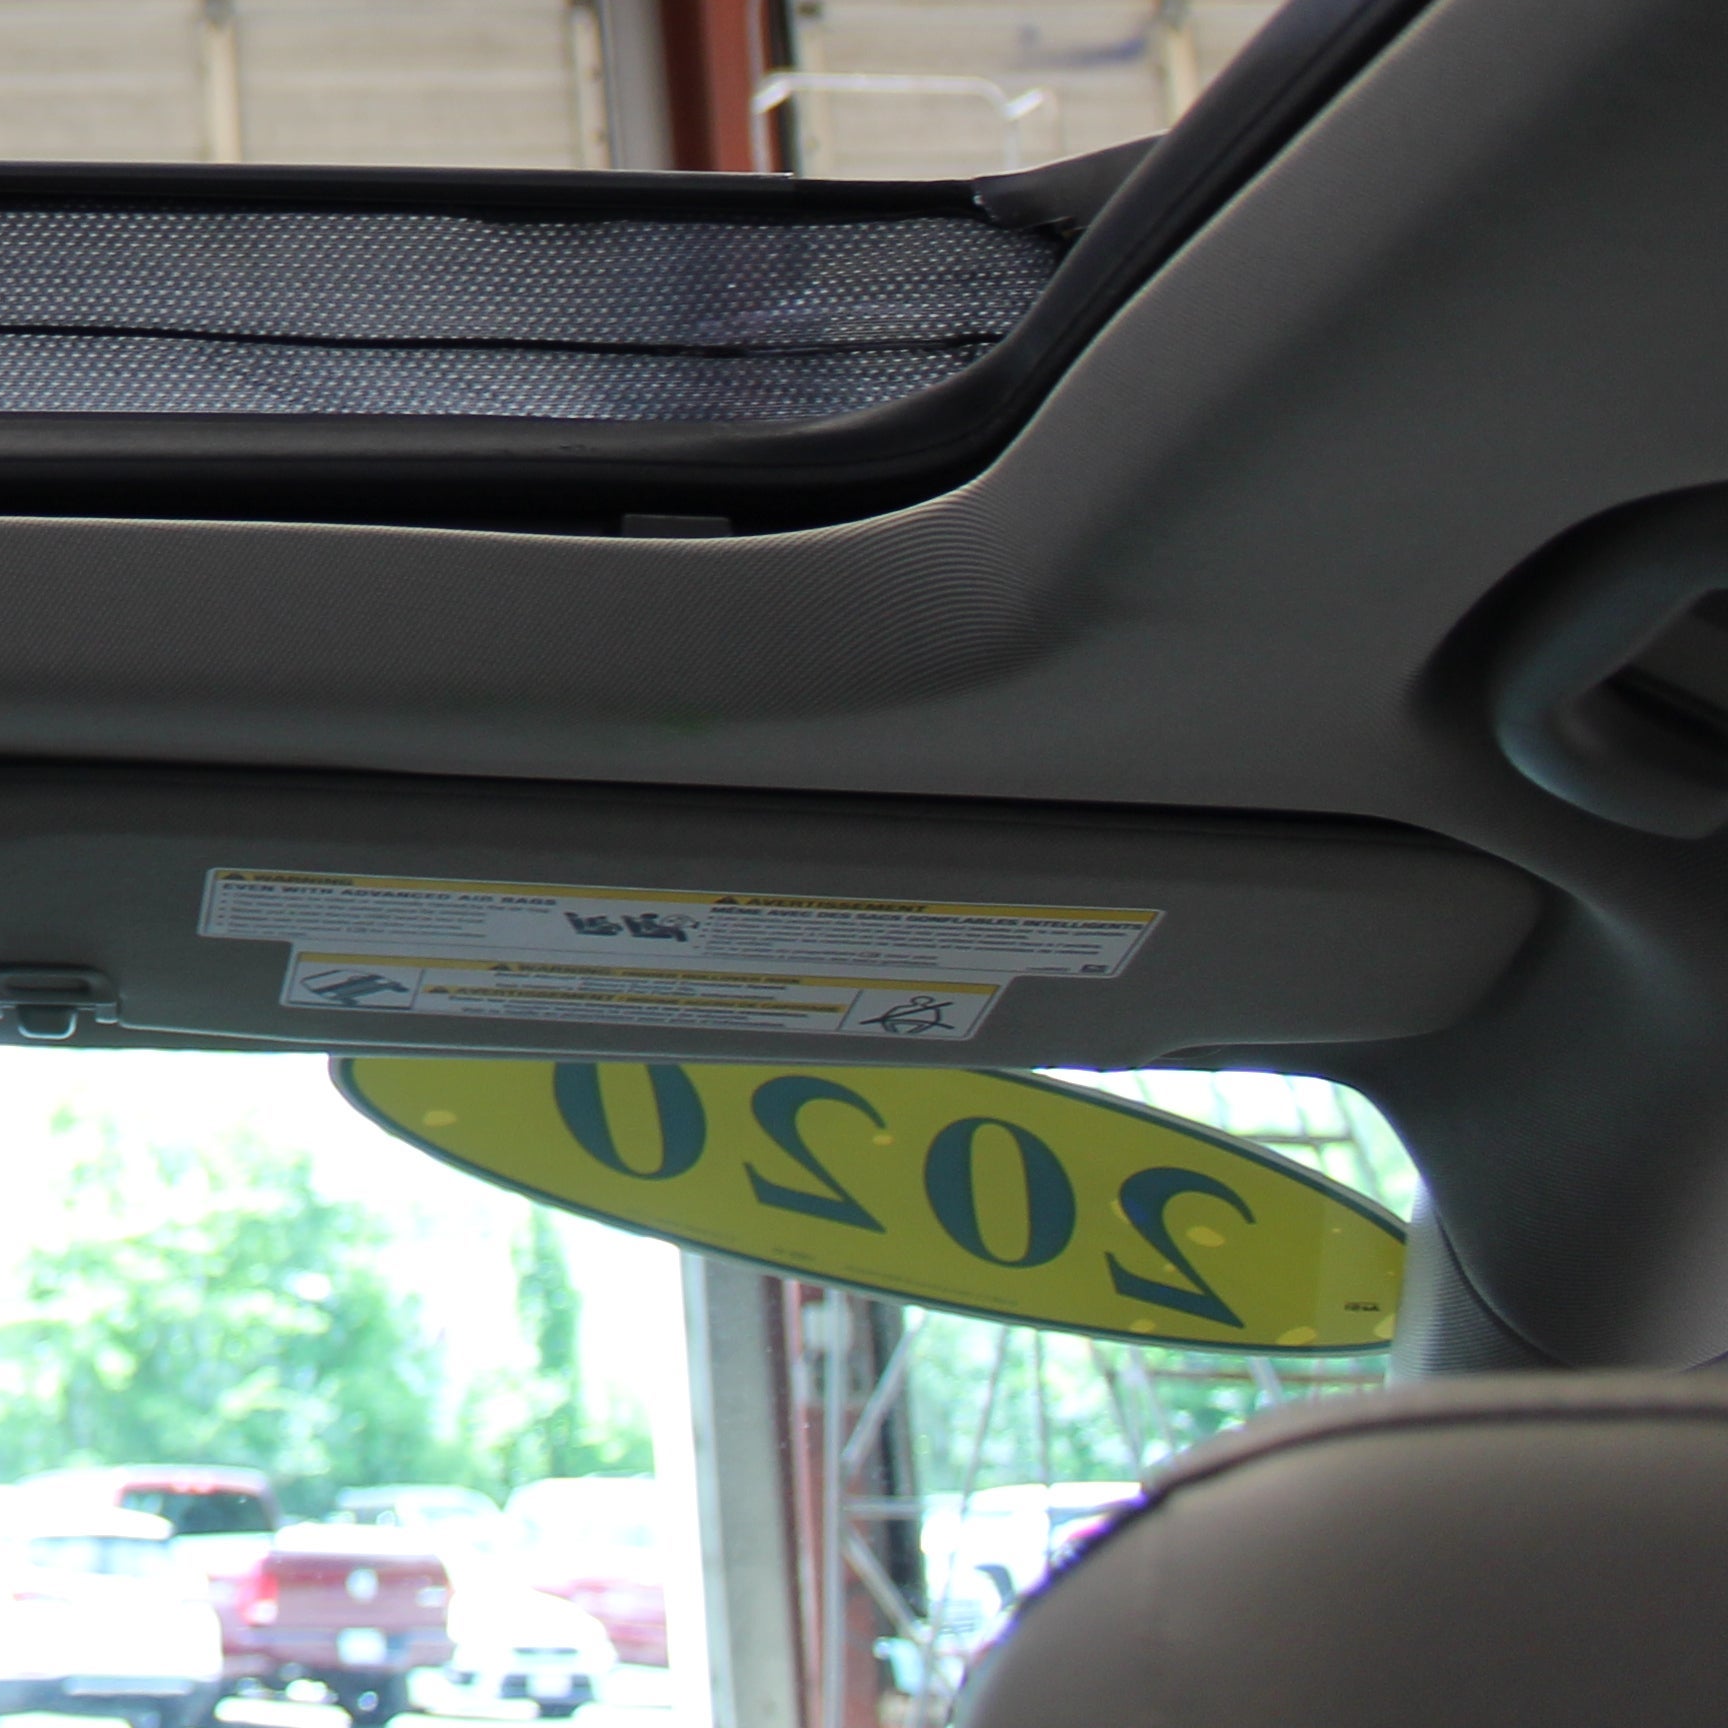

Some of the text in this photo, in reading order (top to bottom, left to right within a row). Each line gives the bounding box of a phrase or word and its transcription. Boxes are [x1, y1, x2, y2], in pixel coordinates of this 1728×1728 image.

[222, 882, 558, 906] EVEN WITH ADVANCED AIR BAGS
[746, 897, 927, 913] AVERTISSEMENT
